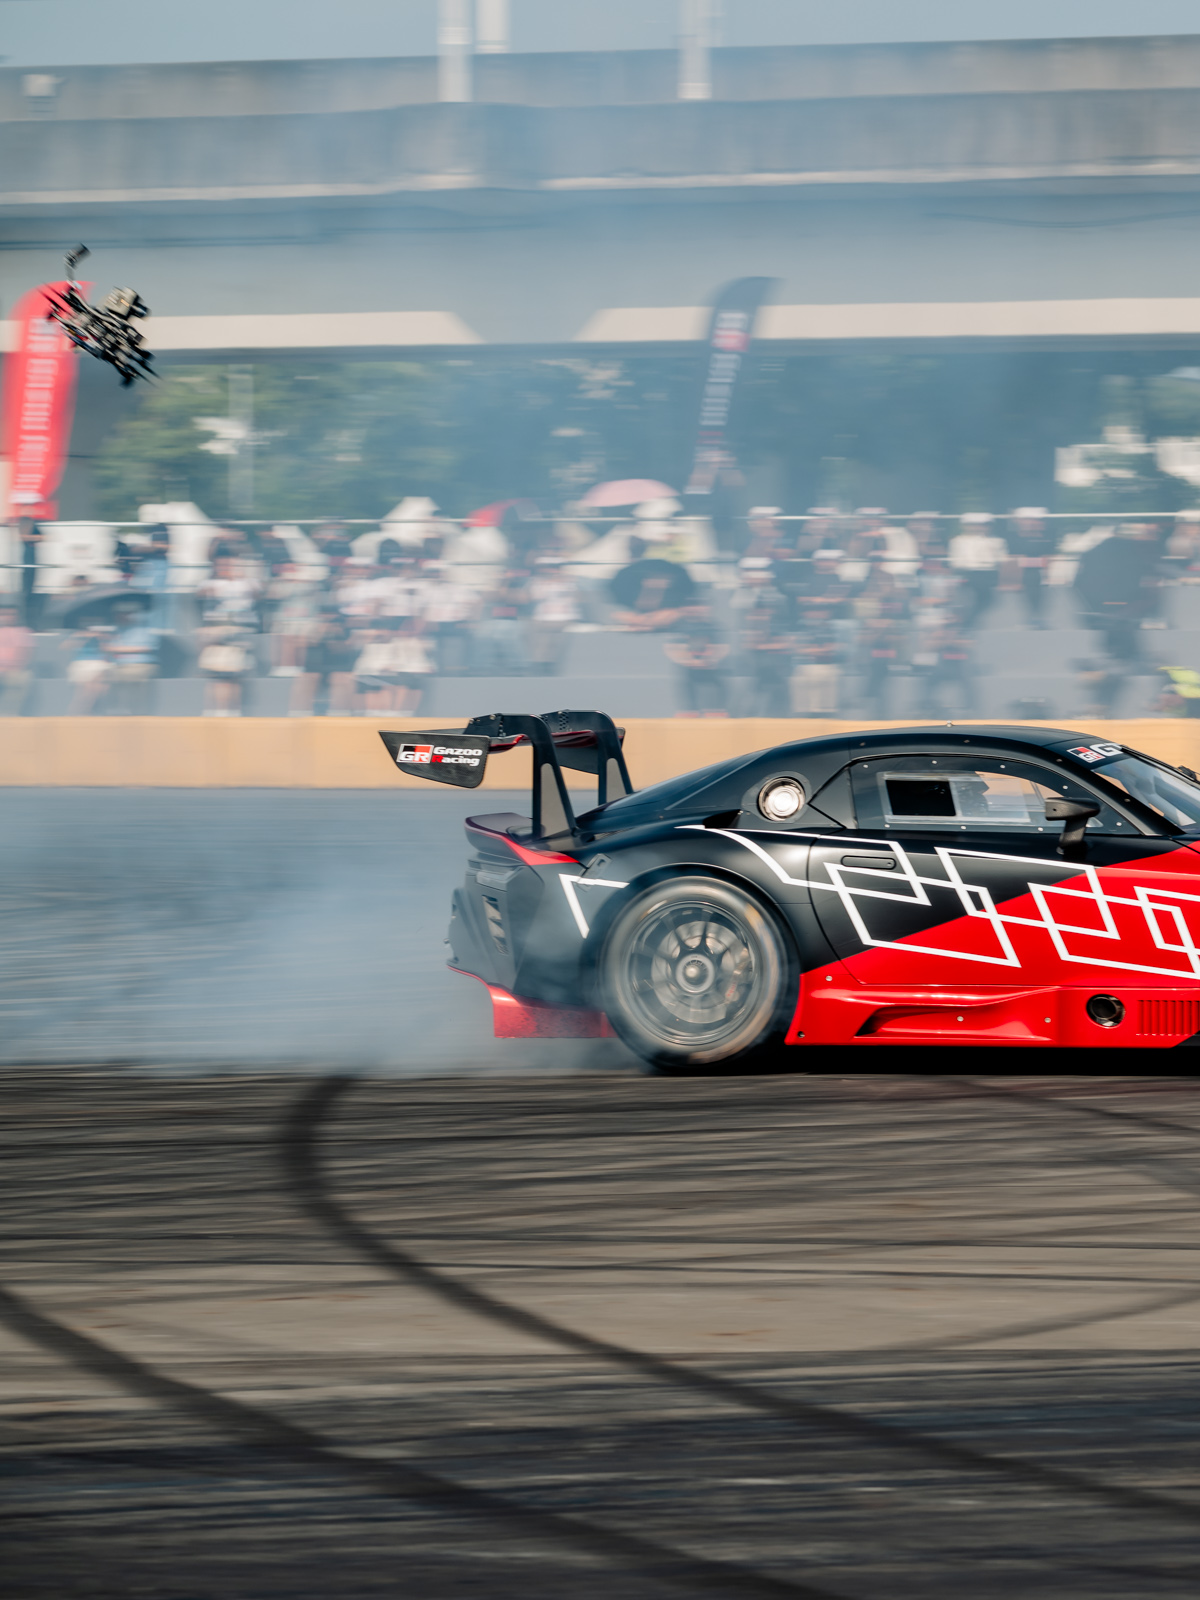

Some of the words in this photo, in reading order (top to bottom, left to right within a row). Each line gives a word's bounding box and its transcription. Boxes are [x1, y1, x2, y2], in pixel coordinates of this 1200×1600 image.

[398, 751, 430, 762] GR
[433, 746, 483, 756] GAZOO
[431, 755, 480, 767] Racing
